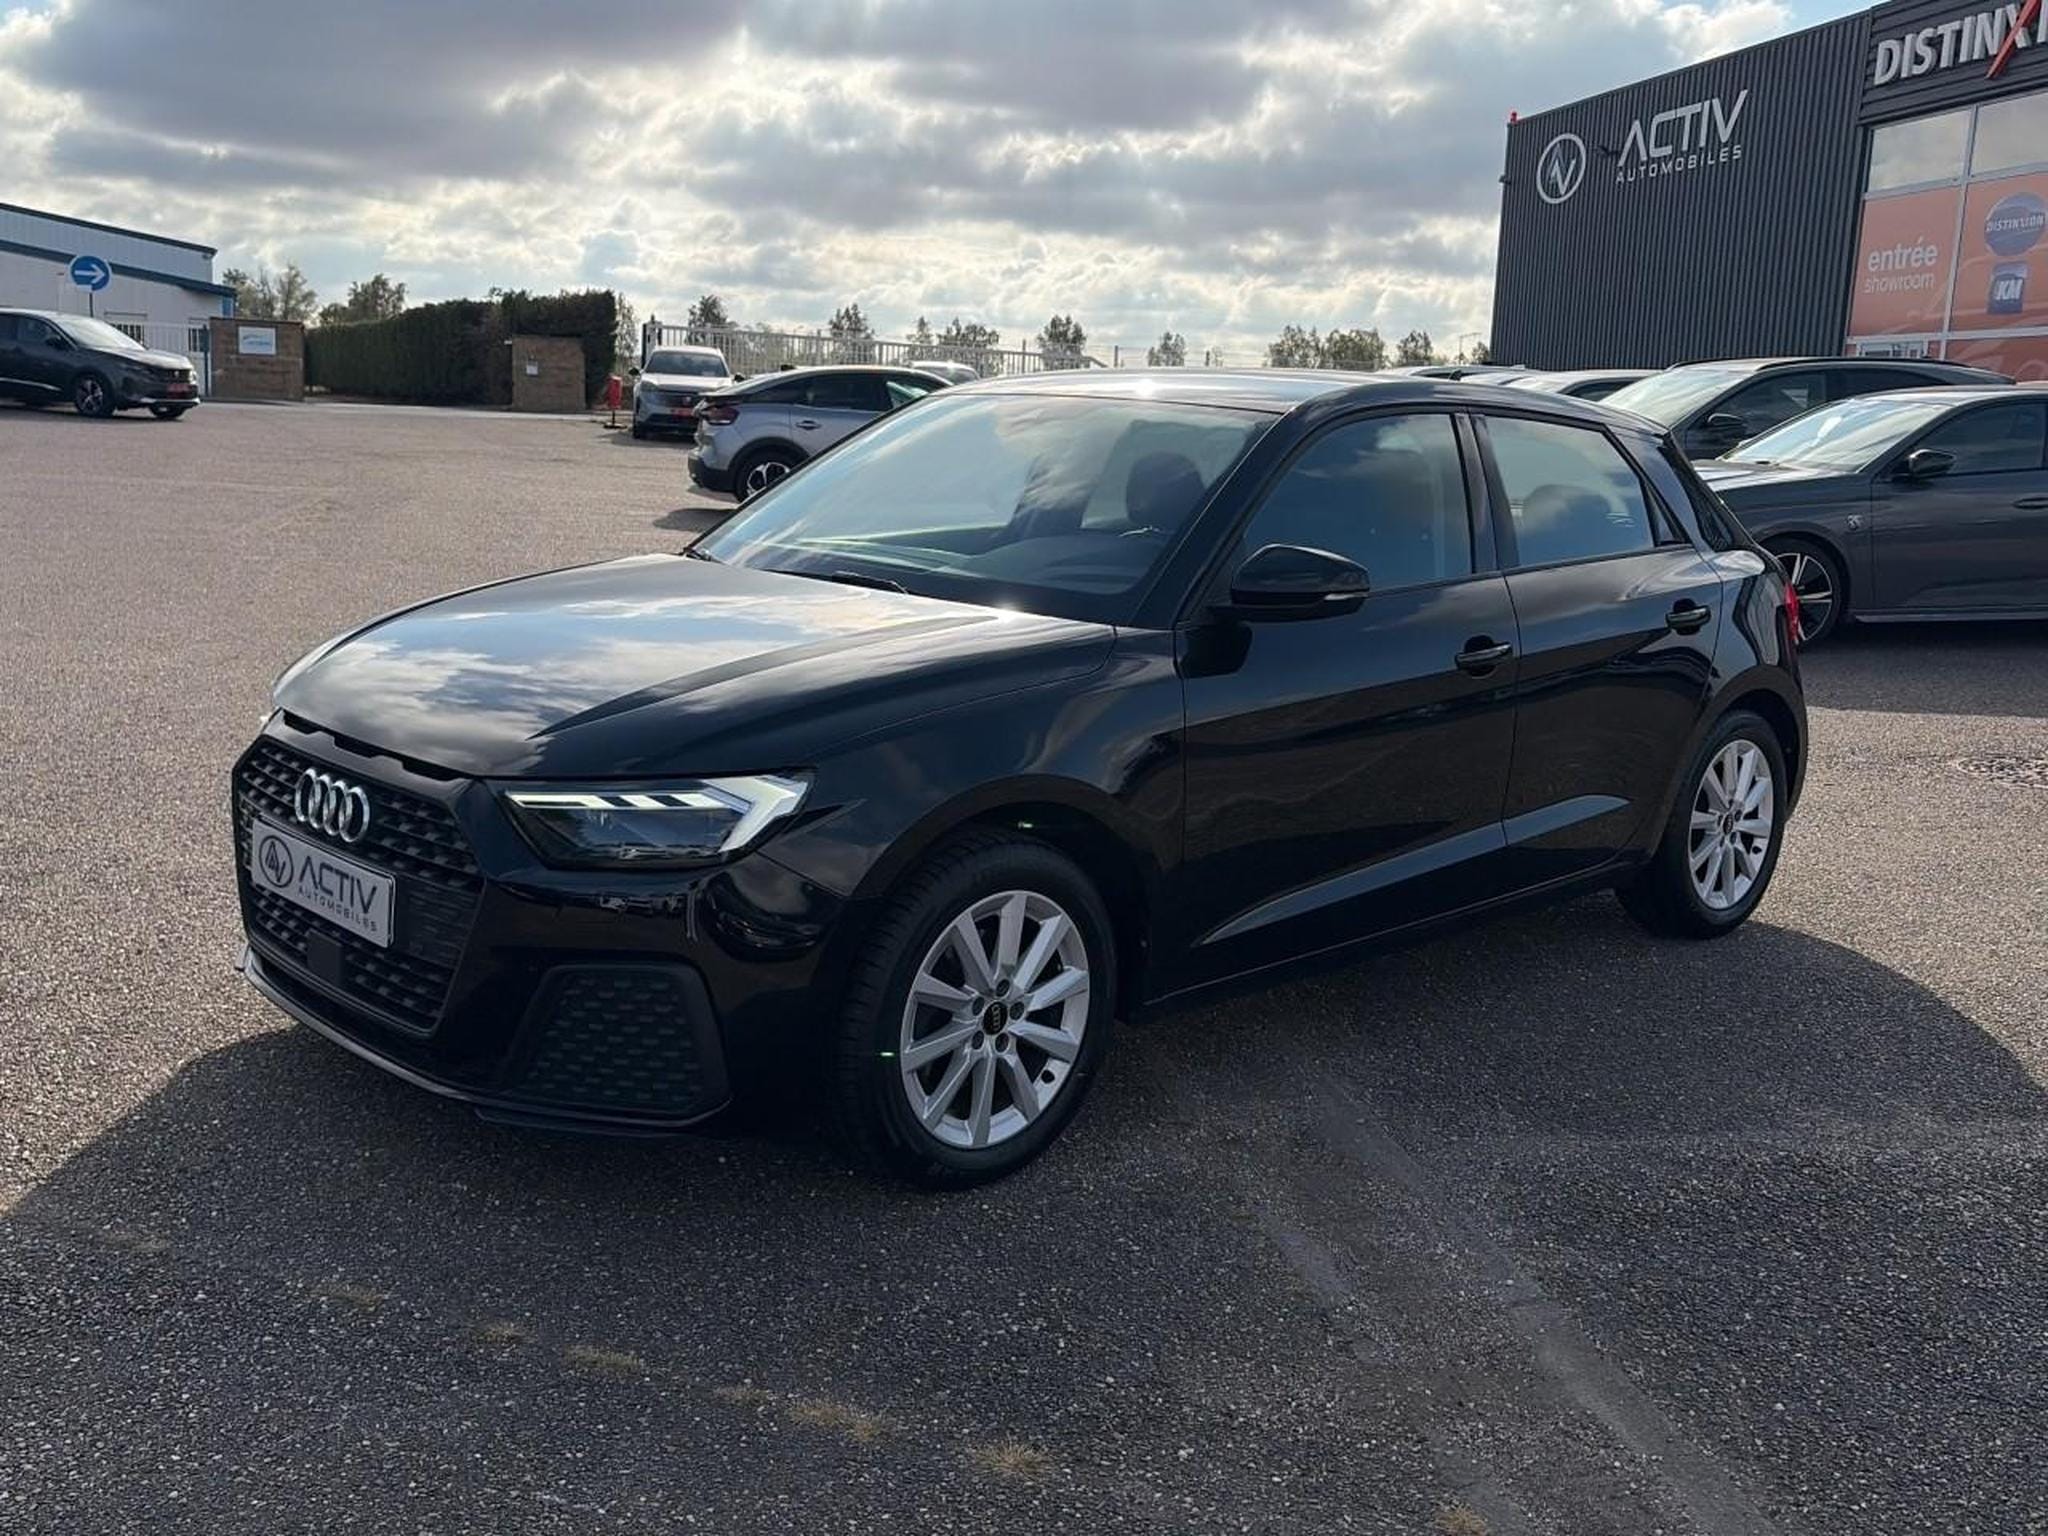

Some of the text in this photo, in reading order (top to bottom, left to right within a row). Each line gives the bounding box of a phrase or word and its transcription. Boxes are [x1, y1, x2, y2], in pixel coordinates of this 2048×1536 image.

[1617, 89, 1749, 168] ACTIV
[1615, 144, 1743, 185] AUTOMOBILES
[1867, 235, 1939, 272] entrée
[1864, 271, 1936, 294] showroom
[299, 855, 378, 915] ACTIV
[298, 886, 378, 933] AUTOMOBILES
